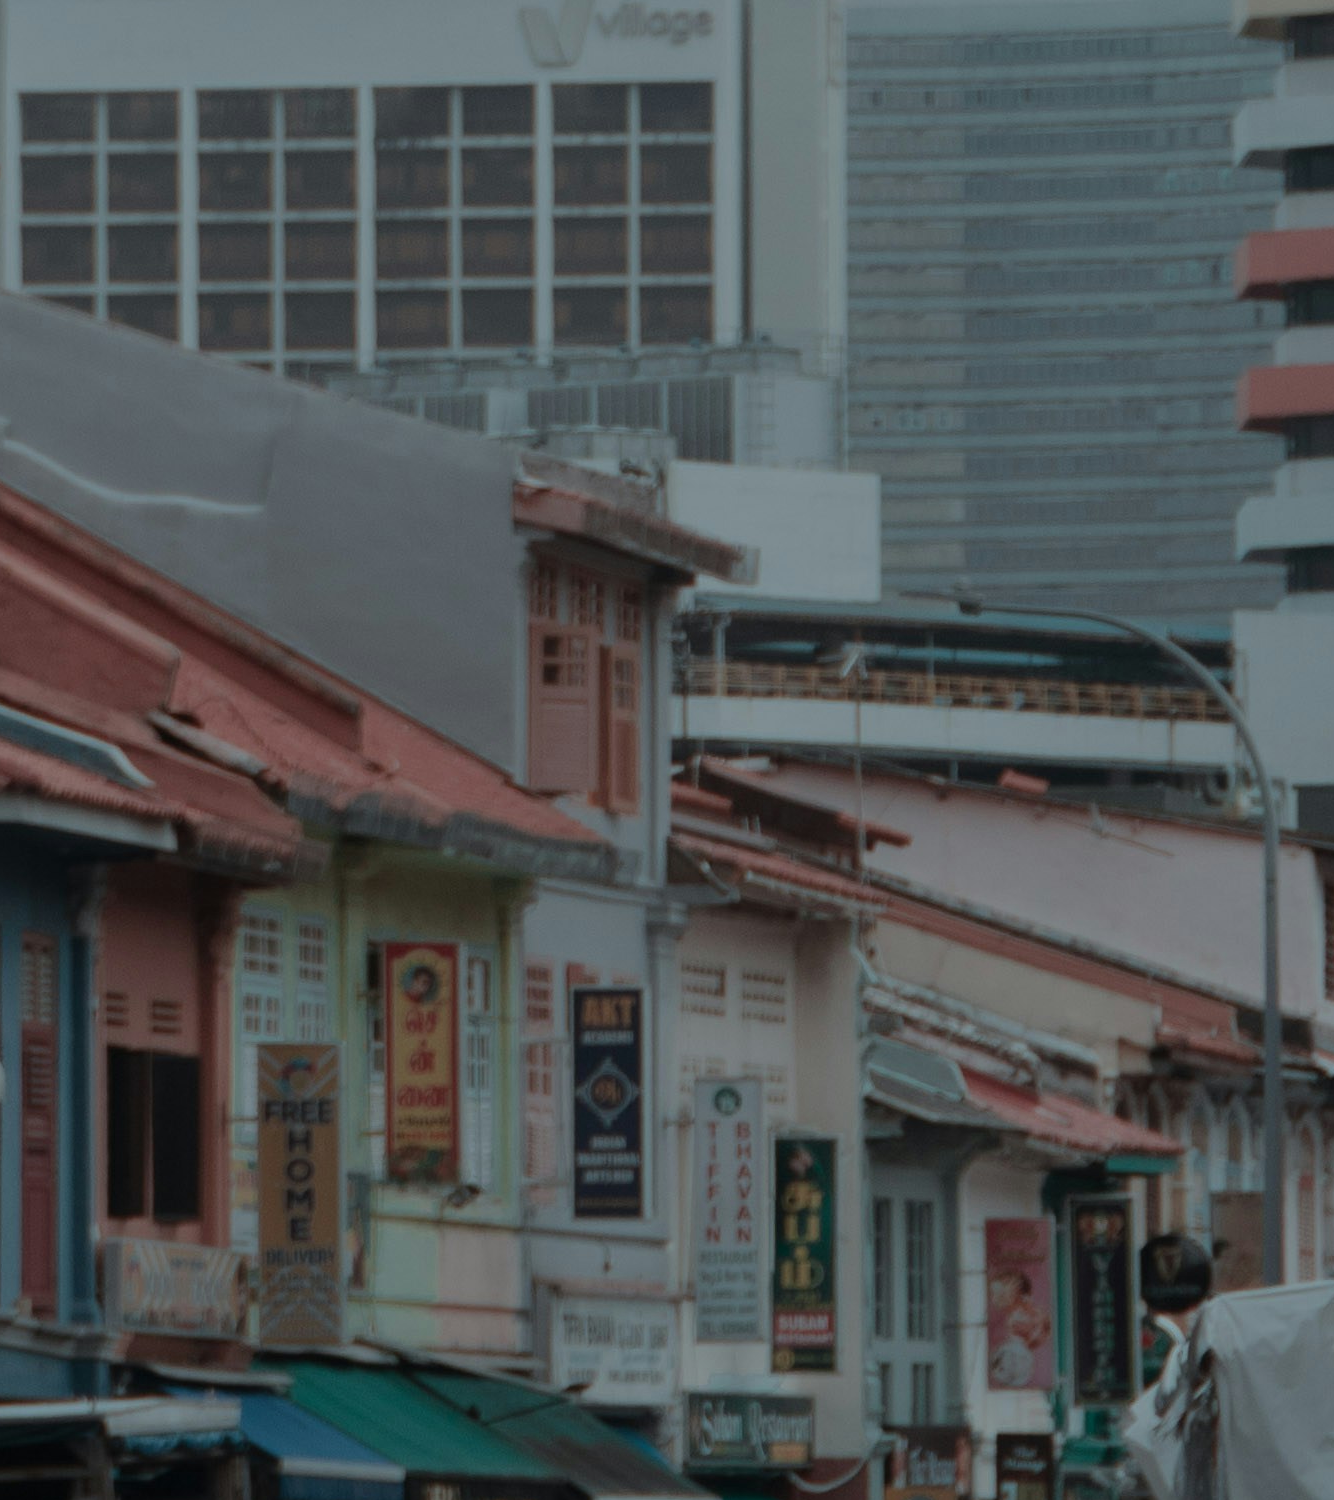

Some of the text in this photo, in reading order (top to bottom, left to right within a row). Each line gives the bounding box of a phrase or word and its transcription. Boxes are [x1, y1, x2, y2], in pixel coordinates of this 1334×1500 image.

[595, 0, 714, 47] village
[581, 993, 636, 1029] AKT
[264, 1100, 333, 1124] FREE
[286, 1129, 314, 1242] HOME
[706, 1121, 721, 1242] TIFFIN
[736, 1121, 753, 1242] BHAVAN
